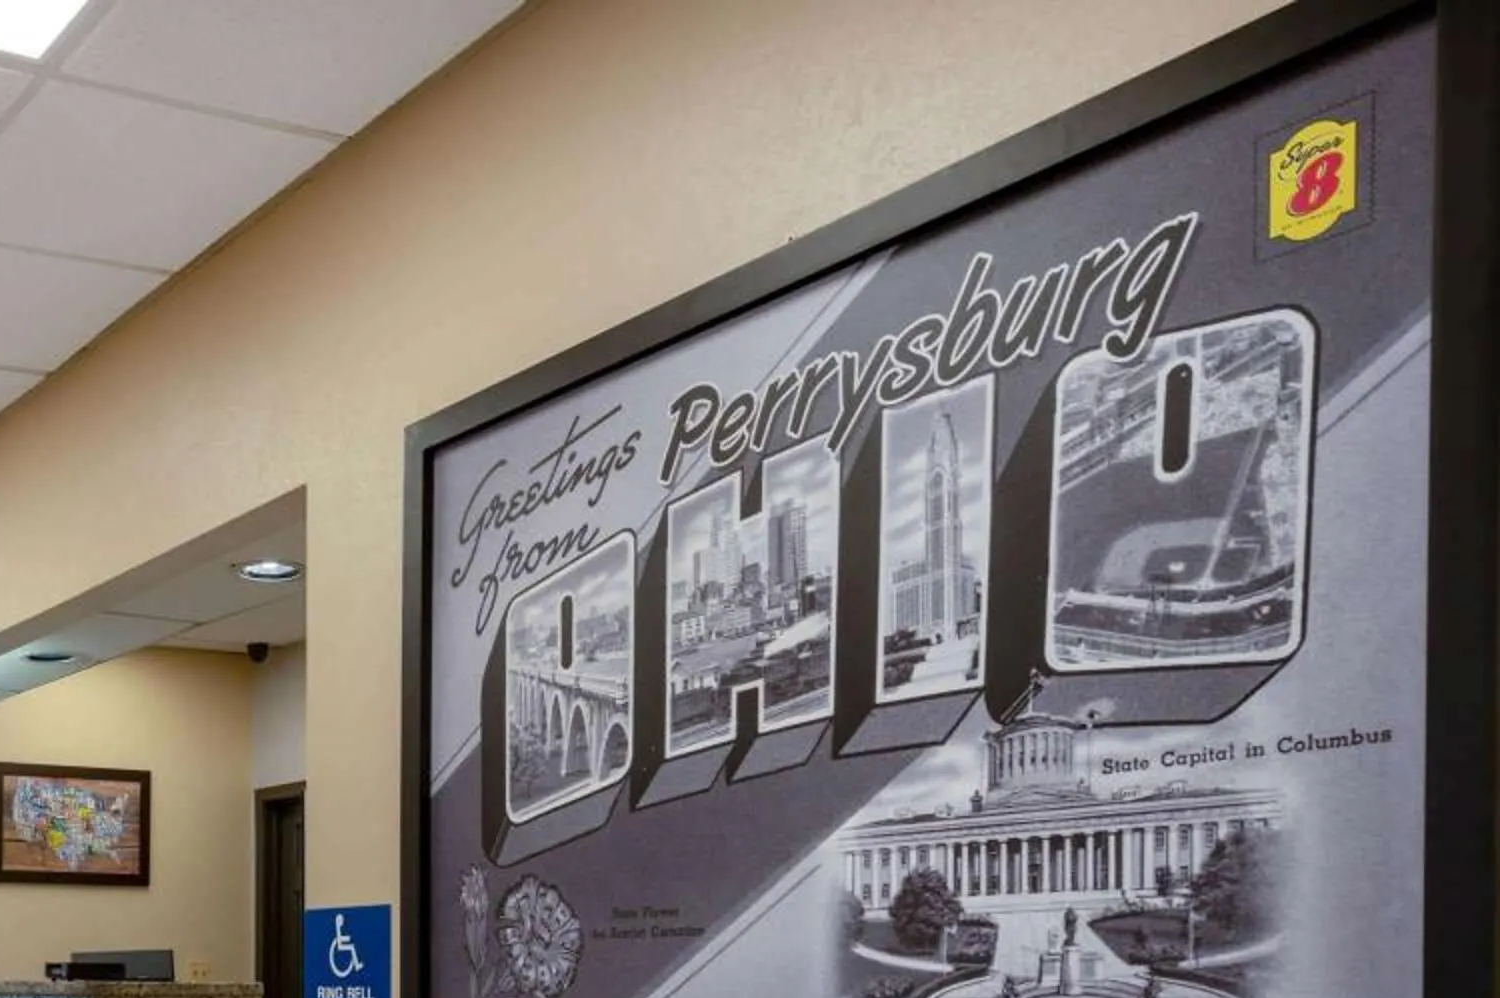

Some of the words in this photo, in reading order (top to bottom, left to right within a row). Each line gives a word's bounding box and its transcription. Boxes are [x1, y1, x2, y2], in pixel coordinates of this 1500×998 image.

[1286, 149, 1346, 217] 8
[657, 210, 1200, 487] Perrysburg
[451, 404, 643, 588] Greetings
[500, 306, 1322, 832] OHIO
[475, 523, 600, 636] from
[1101, 757, 1151, 776] State
[1160, 743, 1235, 771] Capital
[1244, 741, 1266, 760] in
[1276, 728, 1393, 755] Columbus
